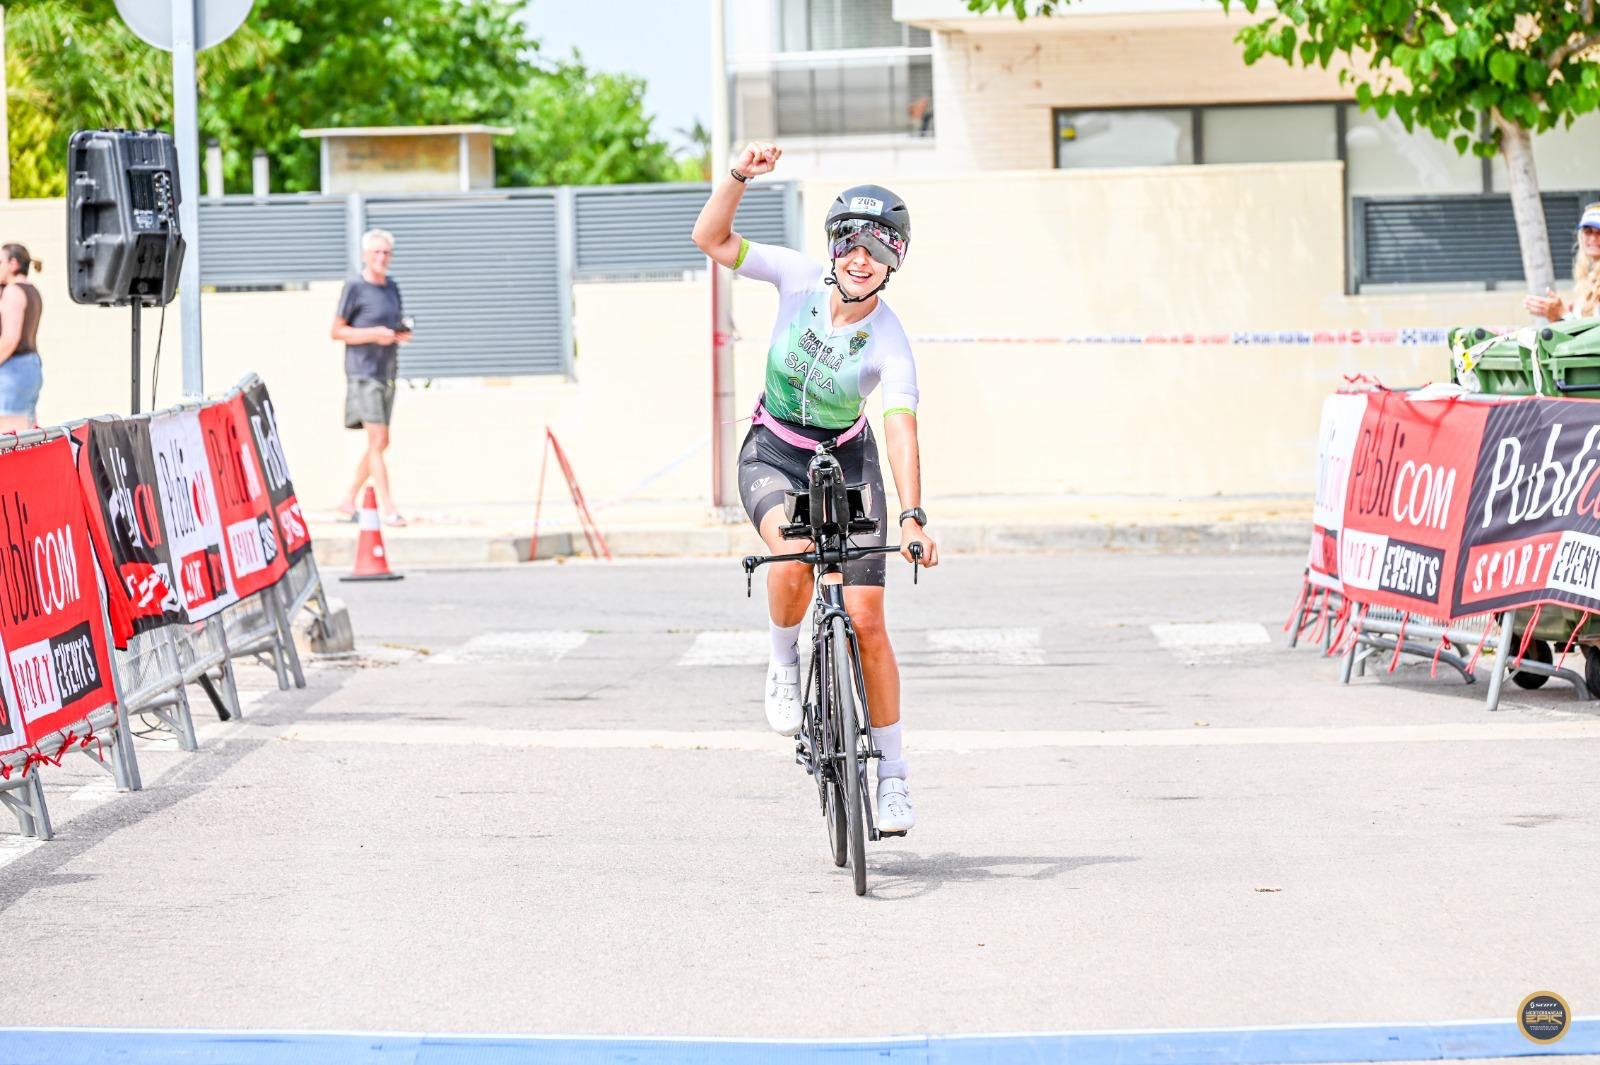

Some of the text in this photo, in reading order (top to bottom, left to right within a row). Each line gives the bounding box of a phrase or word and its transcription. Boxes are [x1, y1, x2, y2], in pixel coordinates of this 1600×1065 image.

[784, 352, 835, 394] SARA
[0, 490, 81, 627] ubliCOM
[1380, 544, 1440, 597] EVENTS
[1472, 542, 1554, 594] SPORT
[53, 634, 97, 699] EVENTS
